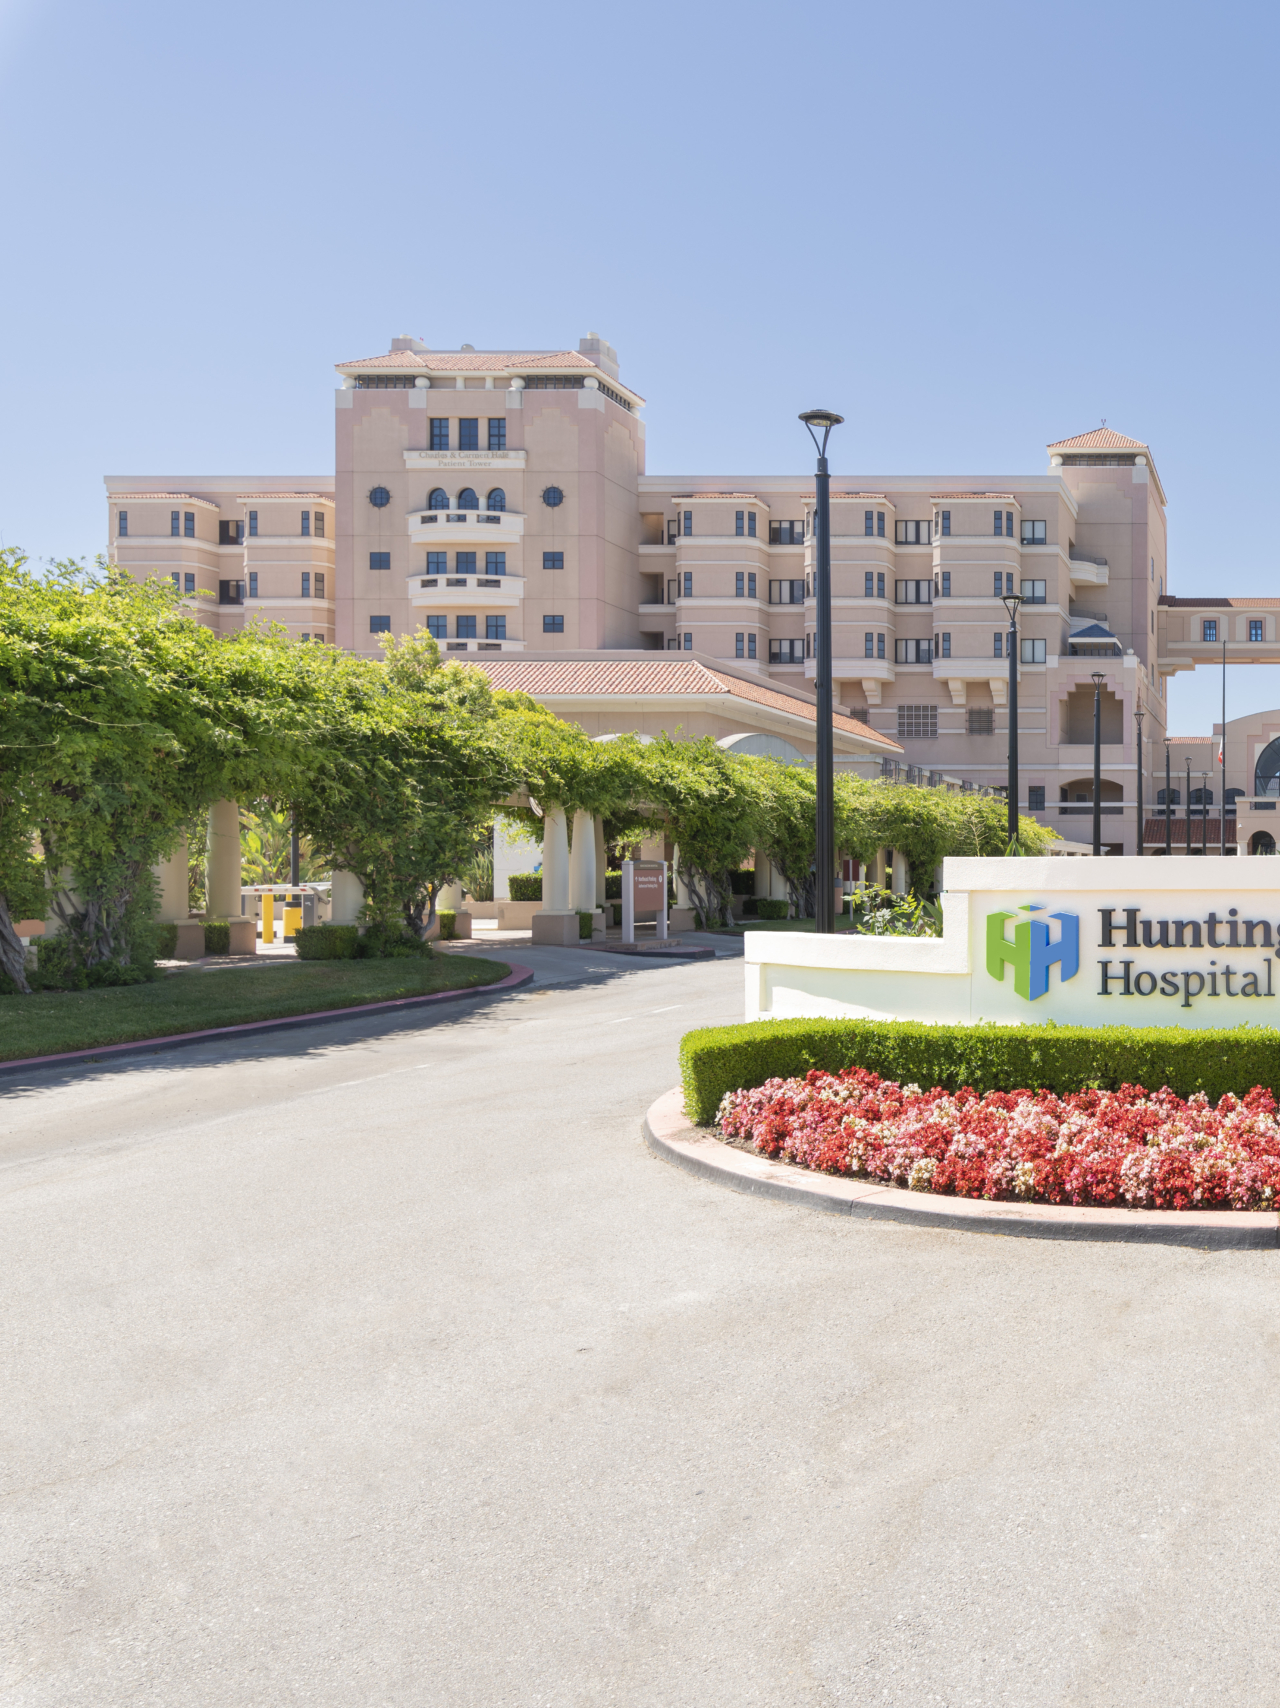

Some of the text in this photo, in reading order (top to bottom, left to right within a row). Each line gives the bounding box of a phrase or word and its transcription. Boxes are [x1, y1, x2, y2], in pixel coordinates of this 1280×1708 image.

[419, 451, 448, 459] Charles
[449, 451, 457, 459] &
[458, 451, 489, 459] Carmen
[1097, 958, 1276, 1008] Hospital
